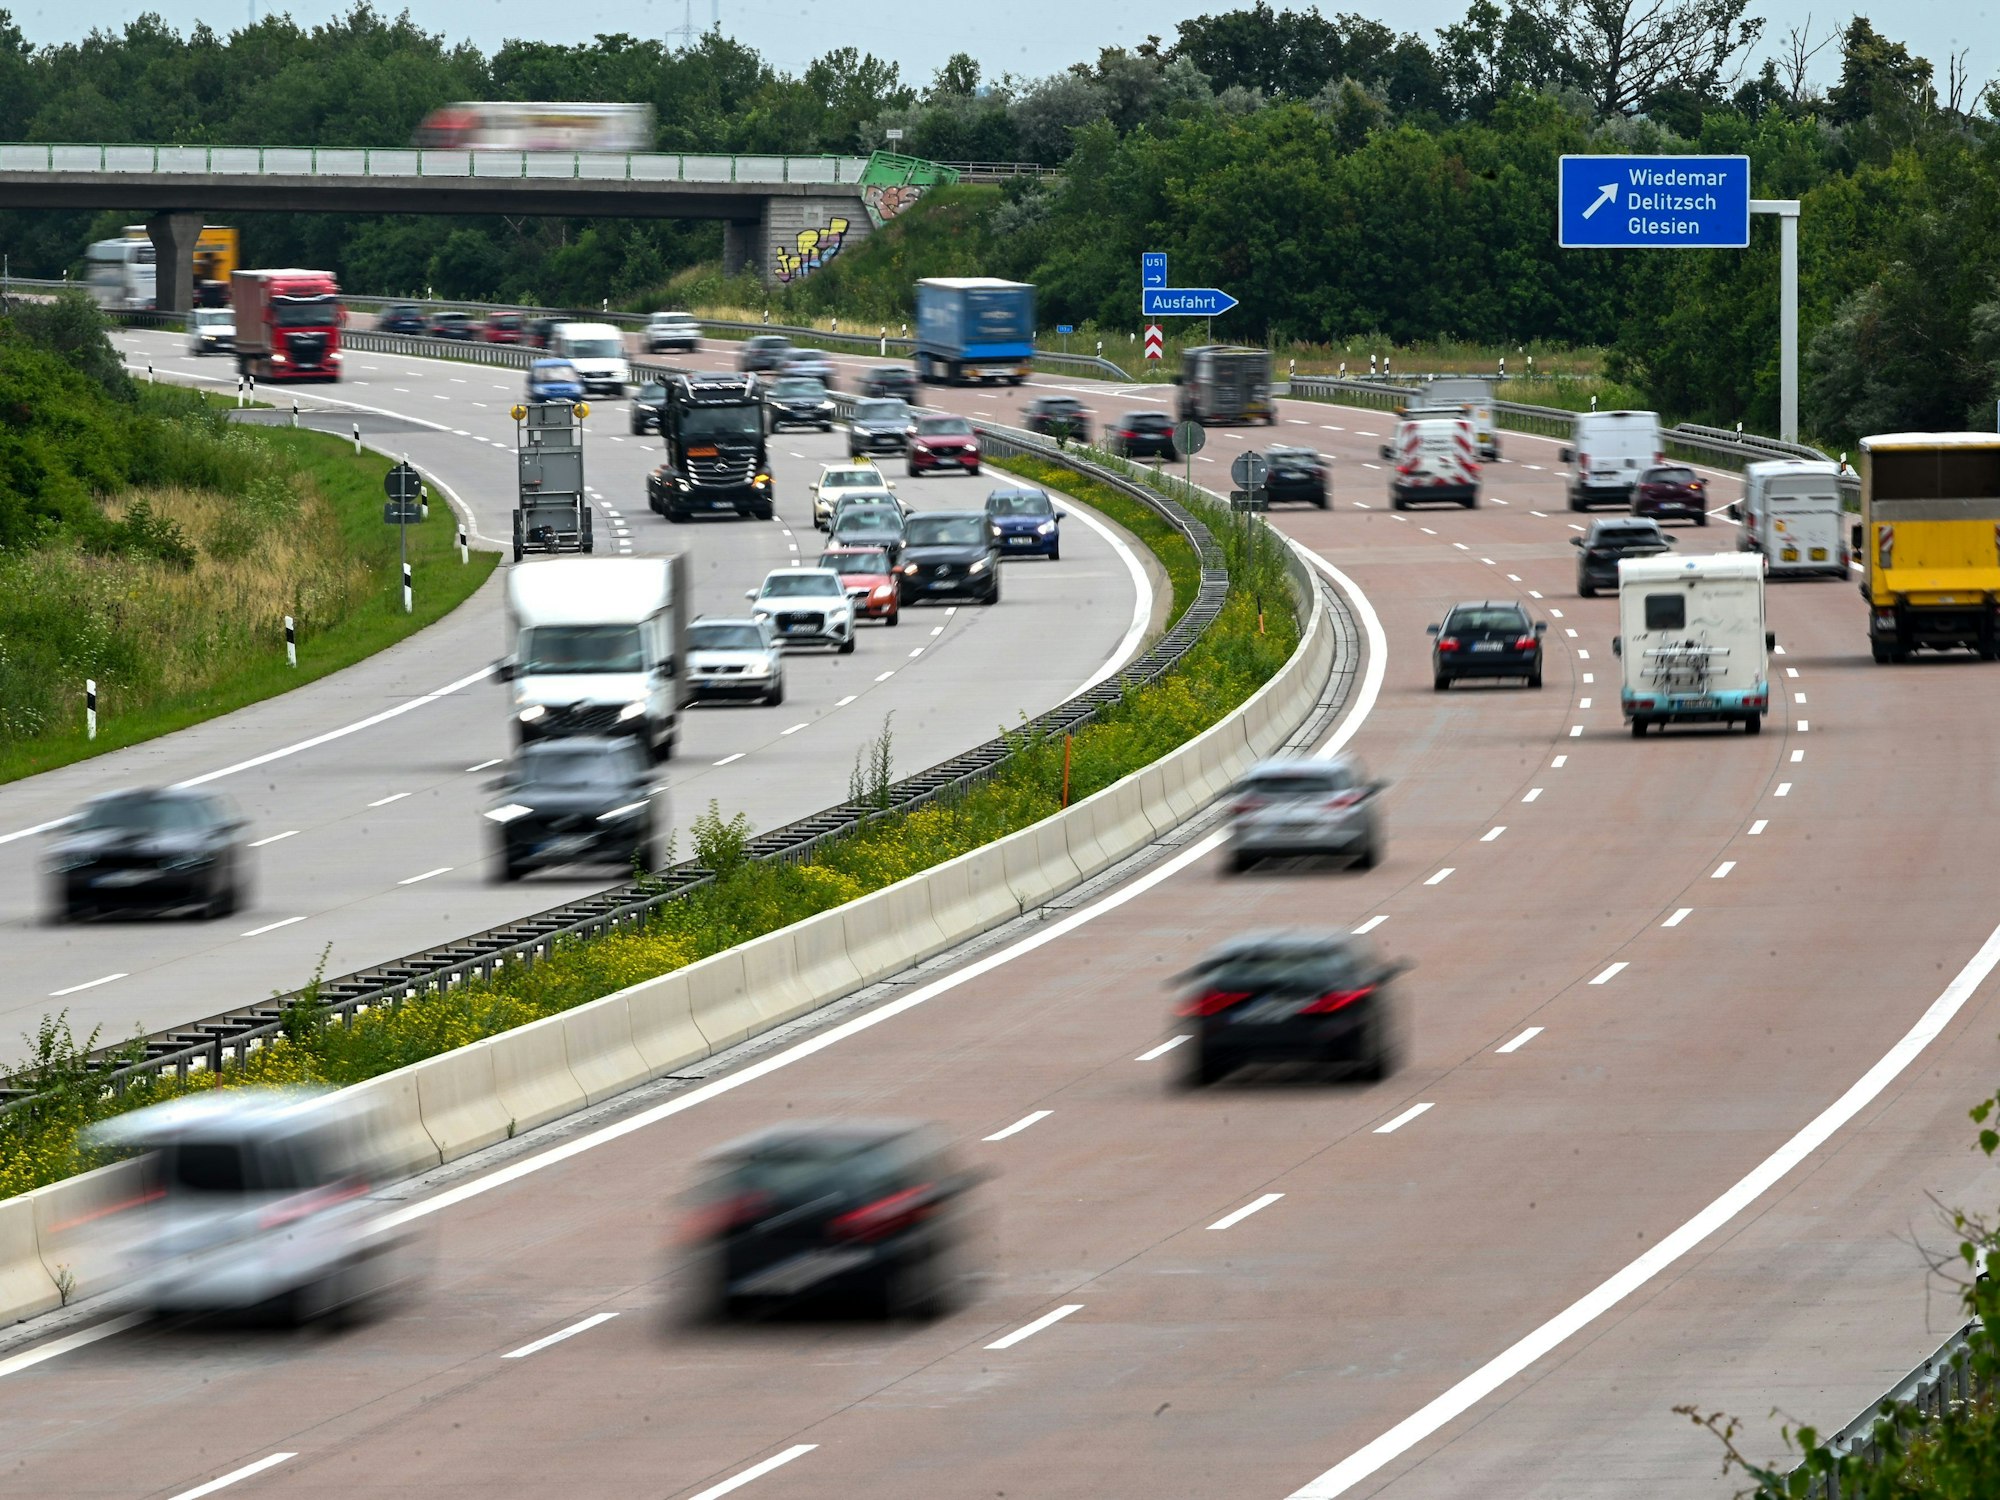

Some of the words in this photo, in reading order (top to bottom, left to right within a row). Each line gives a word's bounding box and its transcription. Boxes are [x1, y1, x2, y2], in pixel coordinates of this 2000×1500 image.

[1628, 168, 1727, 186] Wiedemar
[1628, 192, 1717, 210] Delitzsch
[1628, 217, 1700, 234] Glesien
[1152, 295, 1216, 309] Ausfahrt
